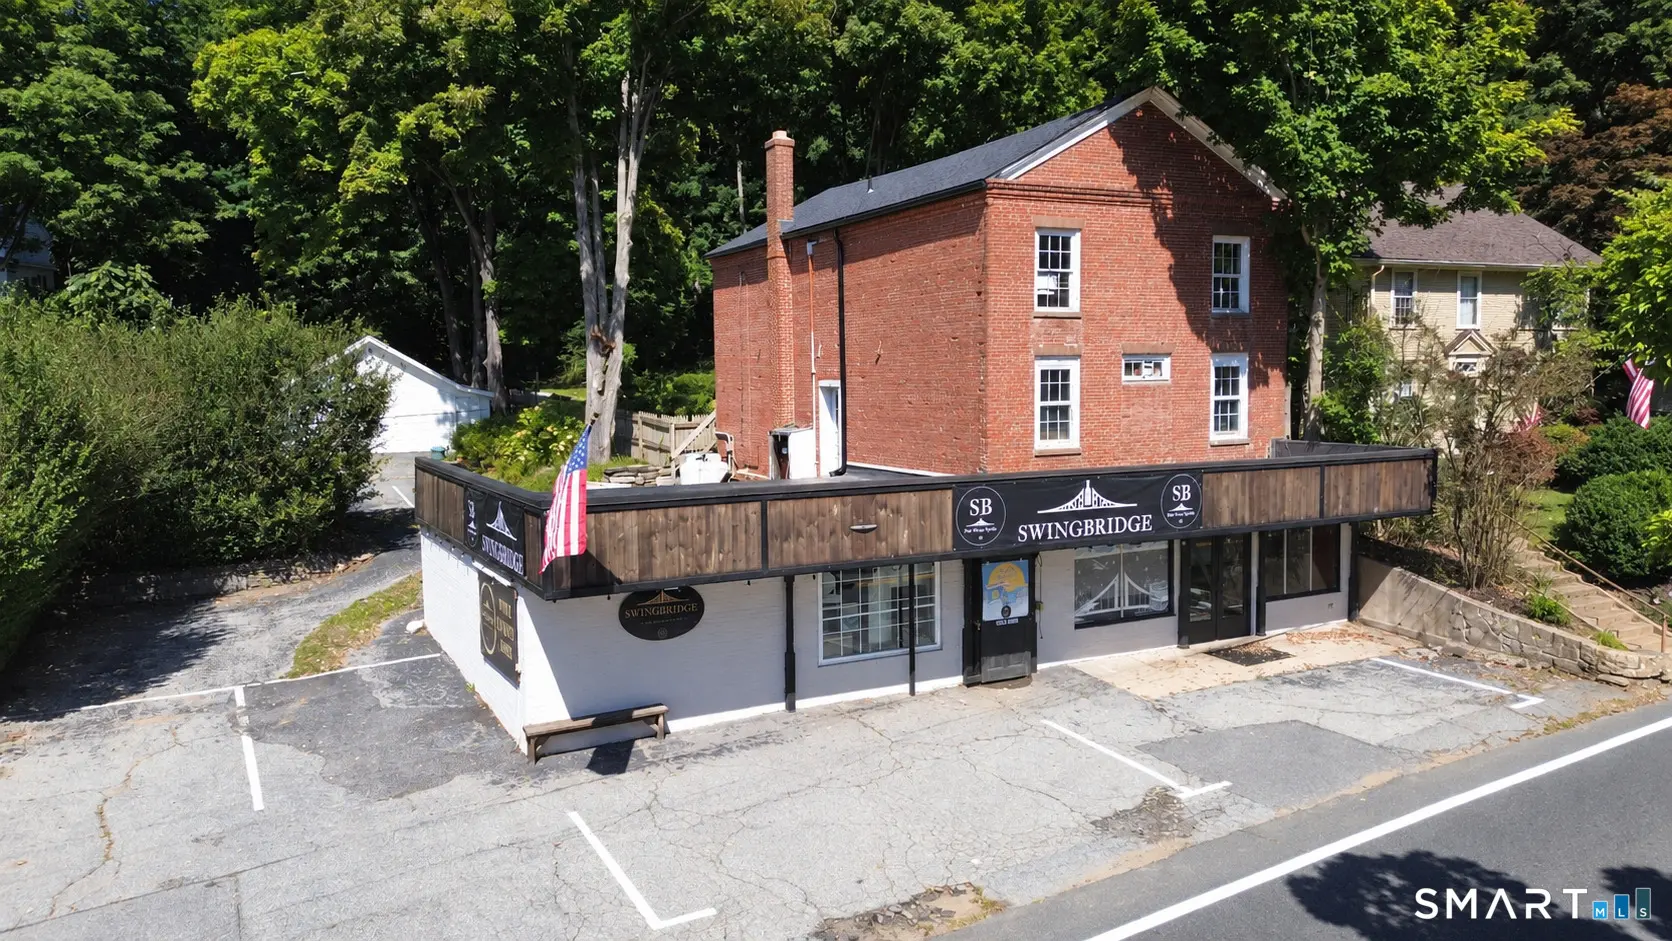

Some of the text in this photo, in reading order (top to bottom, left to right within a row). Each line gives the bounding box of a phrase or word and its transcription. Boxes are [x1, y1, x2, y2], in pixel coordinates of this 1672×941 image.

[1172, 484, 1192, 502] SB
[969, 498, 993, 516] SB
[1017, 514, 1153, 542] SWINGBRIDGE
[625, 603, 698, 619] SWINGBRIDGE
